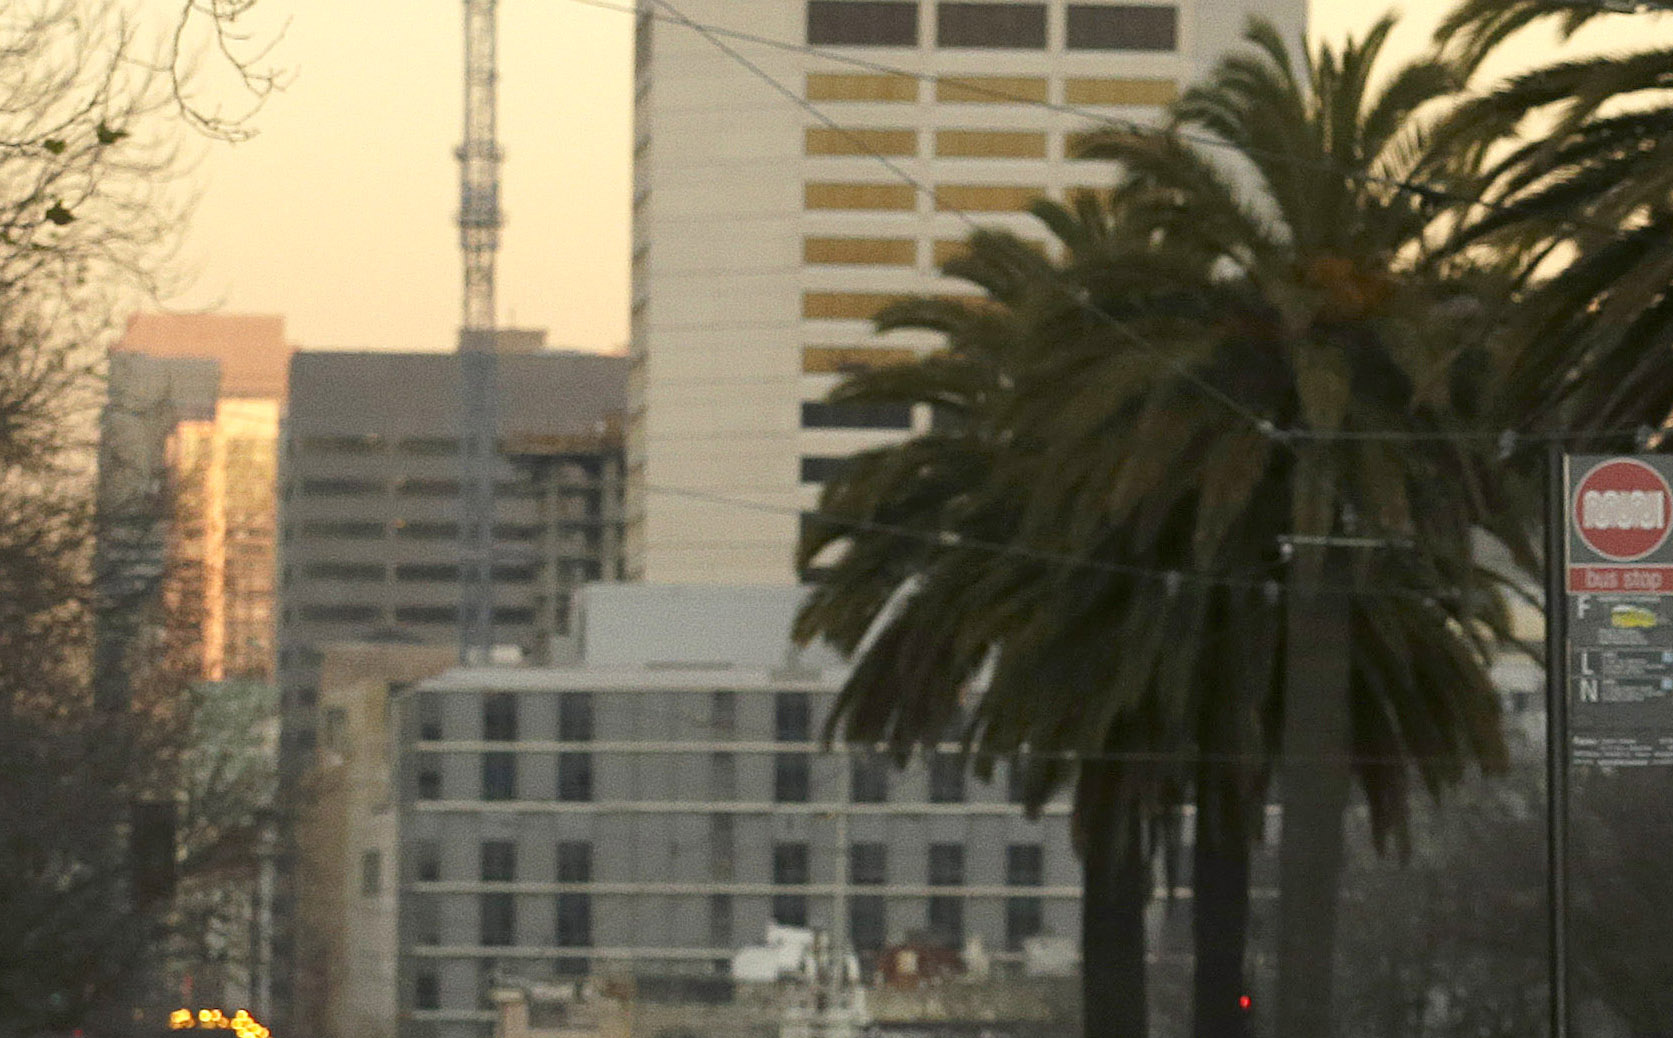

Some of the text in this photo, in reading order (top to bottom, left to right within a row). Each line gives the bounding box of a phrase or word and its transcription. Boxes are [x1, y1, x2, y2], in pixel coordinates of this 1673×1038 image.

[1585, 568, 1662, 591] bus stop
[1577, 595, 1591, 619] F
[1581, 651, 1594, 675] L
[1580, 679, 1598, 702] N
